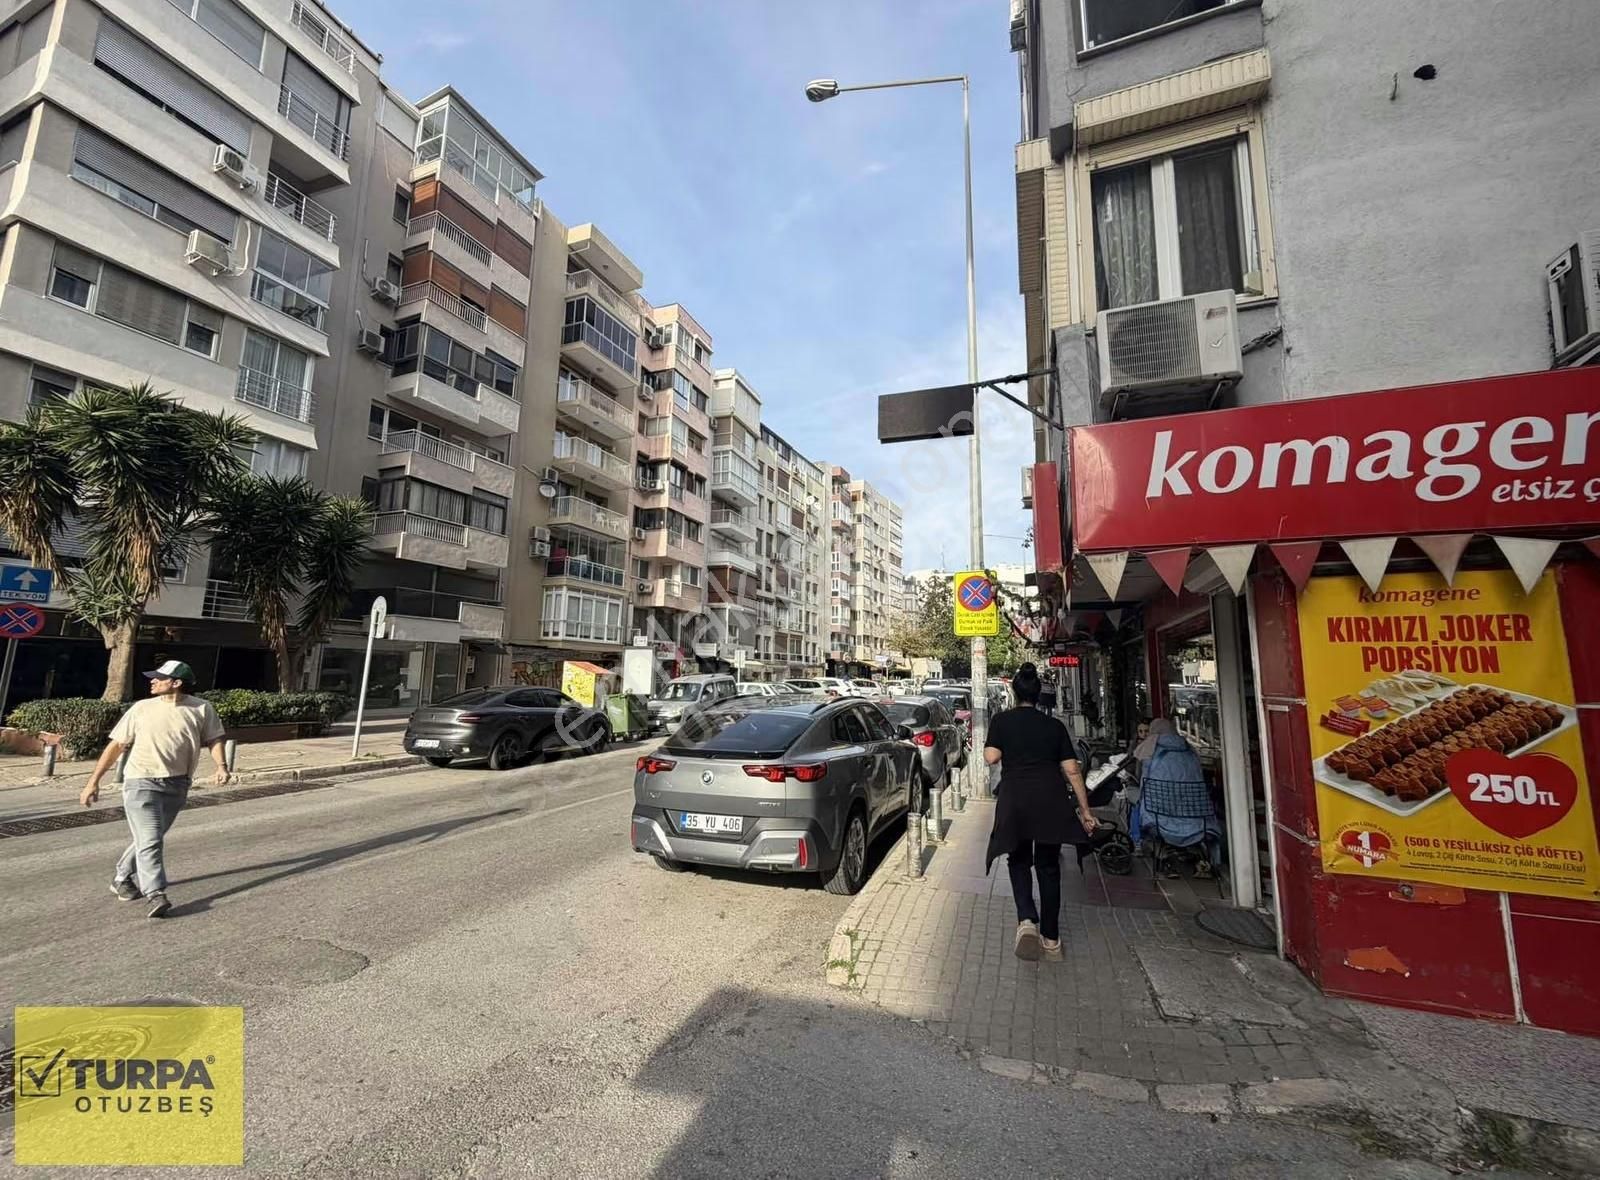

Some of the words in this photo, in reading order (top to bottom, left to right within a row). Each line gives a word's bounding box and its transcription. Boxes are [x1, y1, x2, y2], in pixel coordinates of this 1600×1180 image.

[1491, 477, 1576, 503] etsiz
[1357, 586, 1481, 607] komagene
[1327, 615, 1429, 643] KIRMIZI
[1438, 613, 1534, 642] JOKER
[1361, 640, 1500, 674] PORSİYON
[686, 815, 698, 827] 35
[705, 816, 716, 828] YU
[723, 817, 740, 830] 406
[1347, 844, 1386, 860] NUMARA
[1404, 835, 1431, 848] (500
[1433, 838, 1440, 848] G
[1537, 845, 1584, 862] KÖFTE)
